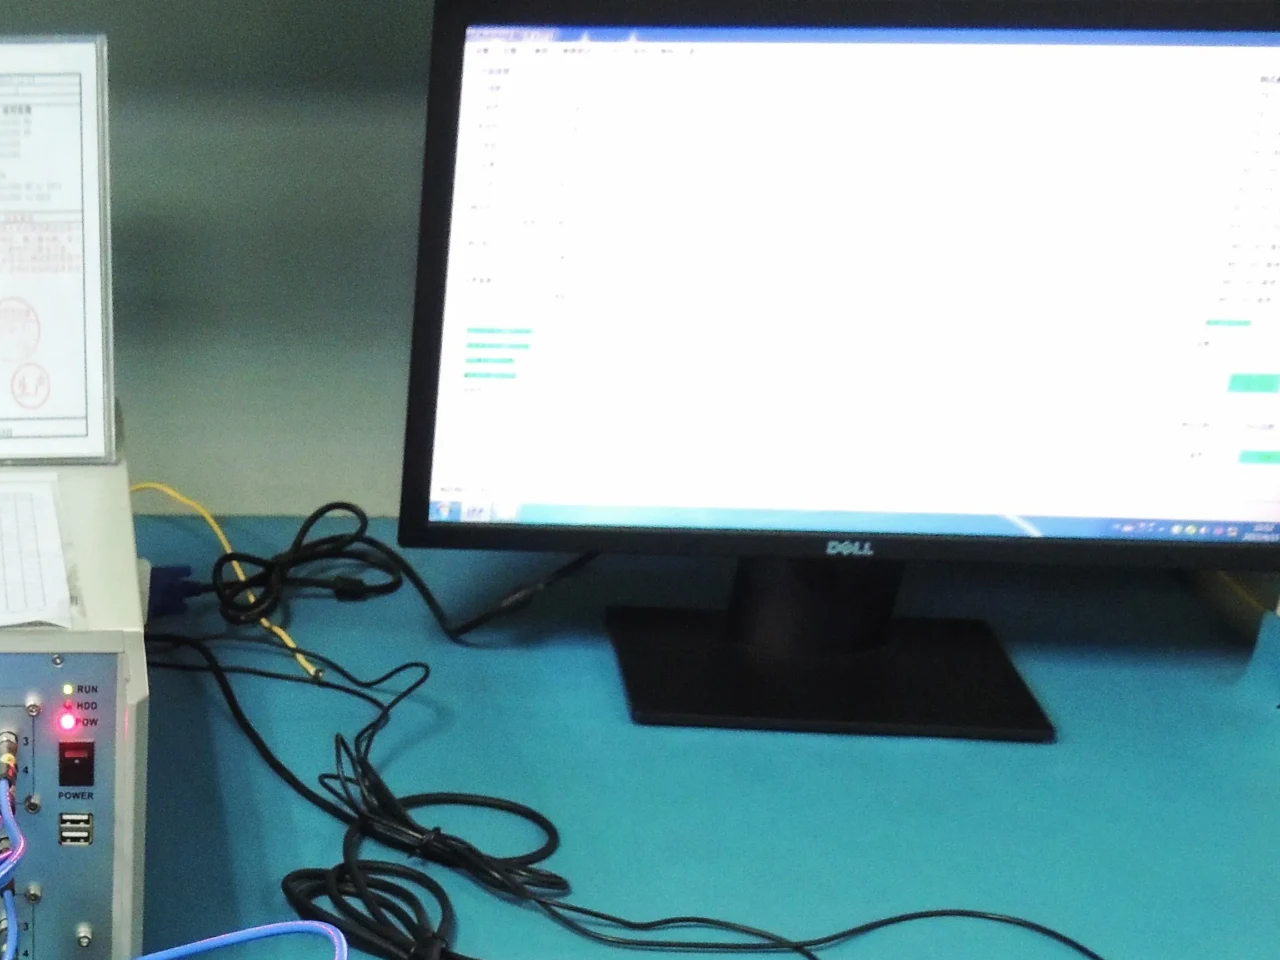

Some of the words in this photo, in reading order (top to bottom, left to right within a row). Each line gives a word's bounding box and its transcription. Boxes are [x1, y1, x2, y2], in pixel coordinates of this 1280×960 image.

[826, 540, 874, 556] DELL
[77, 685, 99, 694] RUN
[76, 702, 98, 710] HDD
[58, 792, 94, 800] POWER
